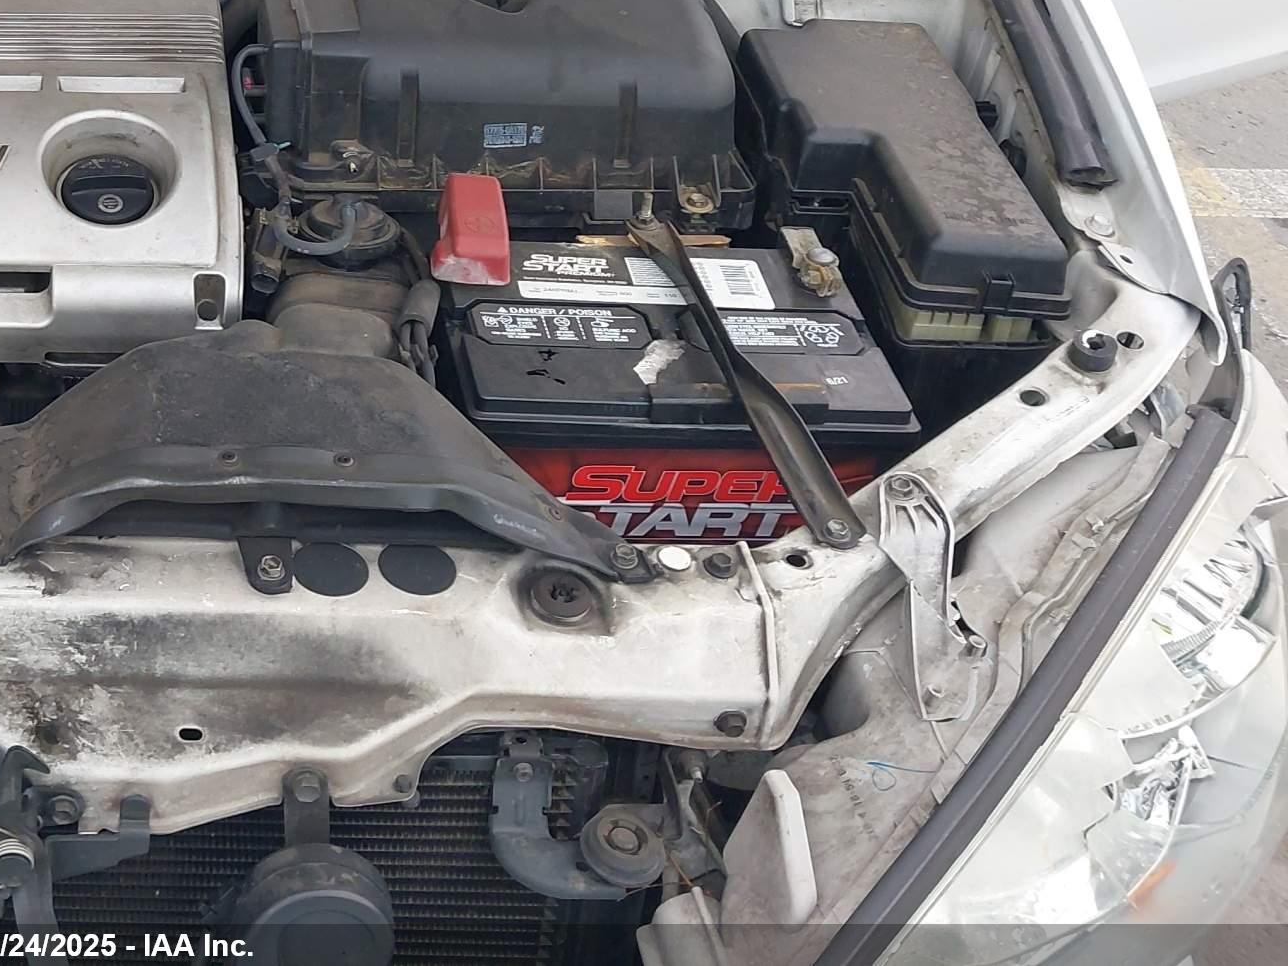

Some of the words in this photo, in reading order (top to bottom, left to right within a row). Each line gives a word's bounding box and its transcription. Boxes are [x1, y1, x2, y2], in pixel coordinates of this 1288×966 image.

[522, 260, 610, 272] START
[530, 254, 608, 266] SUPER
[509, 307, 558, 315] DANGER
[557, 498, 797, 536] TART
